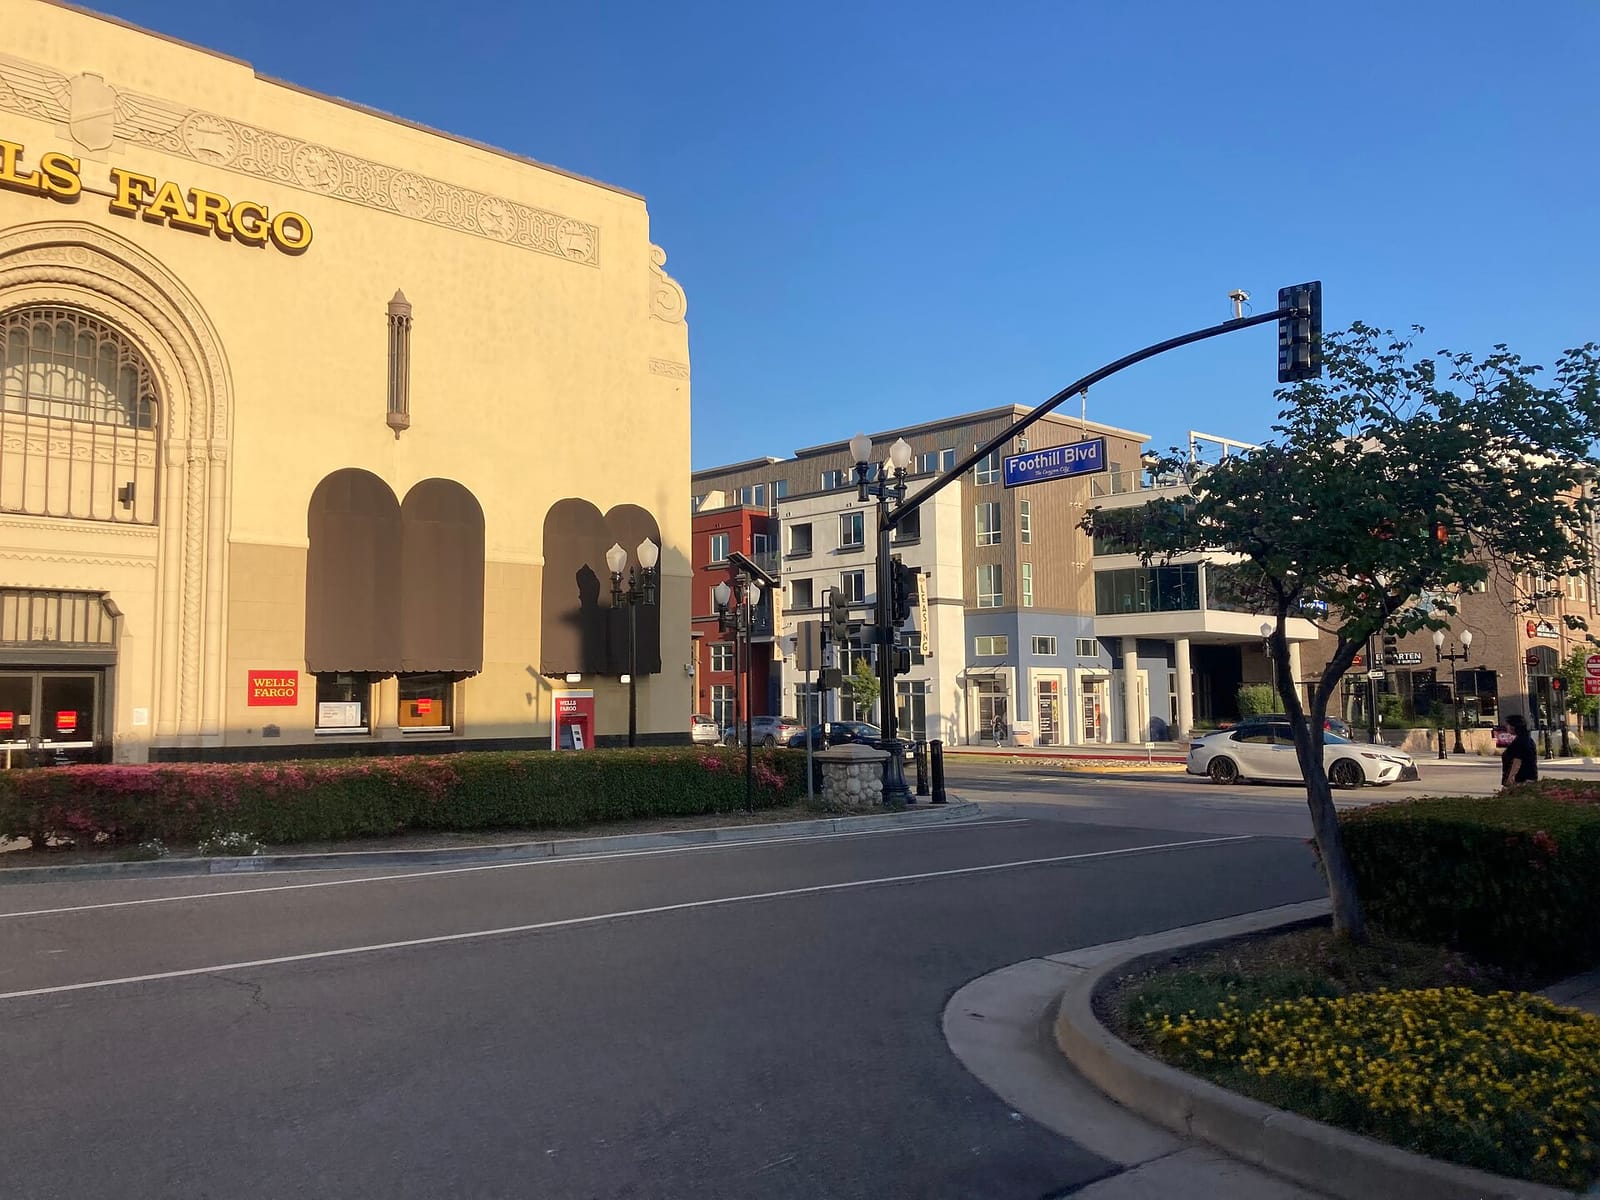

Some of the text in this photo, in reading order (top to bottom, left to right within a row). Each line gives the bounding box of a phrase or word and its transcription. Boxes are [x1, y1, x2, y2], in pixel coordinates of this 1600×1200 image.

[110, 167, 313, 249] FARGO
[1010, 444, 1097, 473] Foothill Blvd
[919, 584, 929, 652] LEASING
[253, 678, 296, 687] WELLS
[254, 688, 295, 697] FARGO
